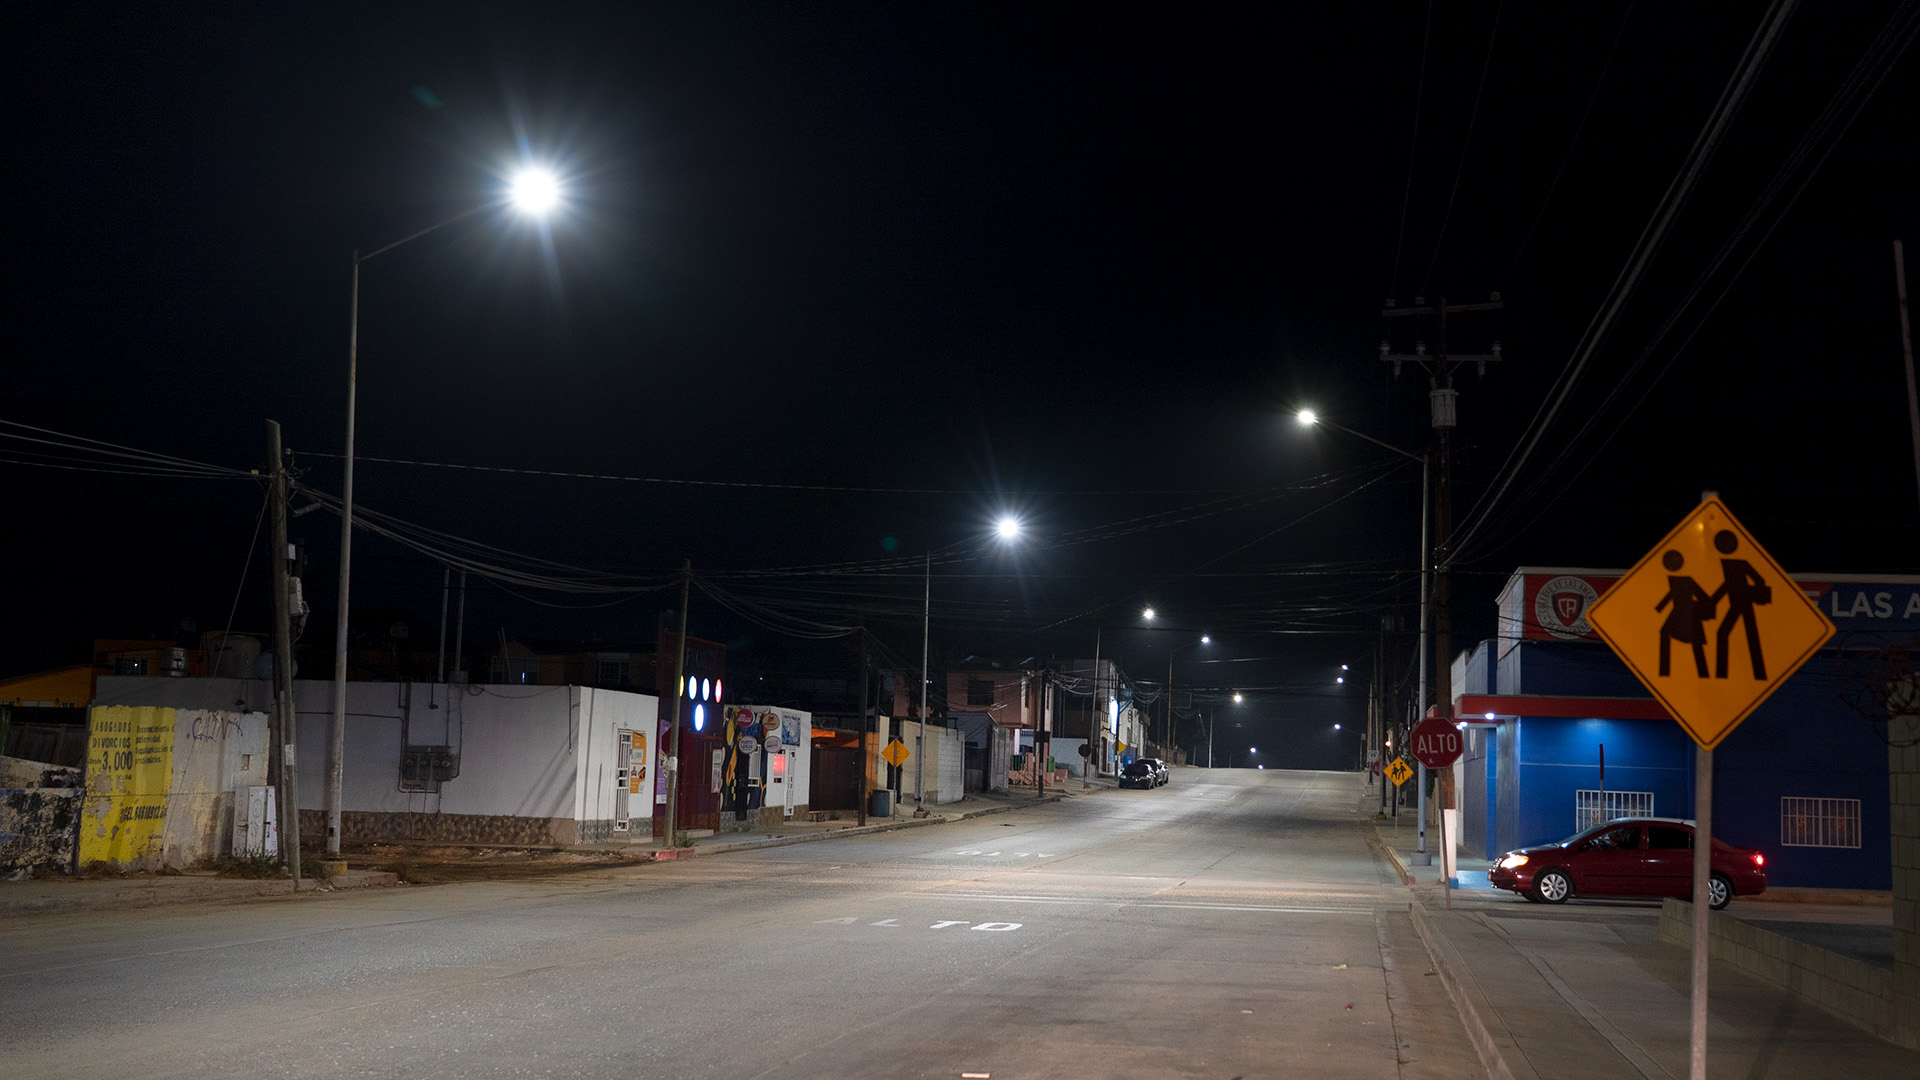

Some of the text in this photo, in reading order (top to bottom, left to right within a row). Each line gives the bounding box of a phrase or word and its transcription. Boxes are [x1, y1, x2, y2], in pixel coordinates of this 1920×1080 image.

[1539, 587, 1554, 613] COLEGIO
[1553, 581, 1562, 589] DE
[1565, 580, 1577, 588] LAS
[1832, 591, 1894, 618] LAS
[95, 722, 132, 733] ABOGADOS
[93, 737, 132, 749] DIVORCIOS
[1418, 733, 1457, 754] ALTO
[102, 751, 133, 772] 3,000
[821, 916, 1023, 931] ALTO
